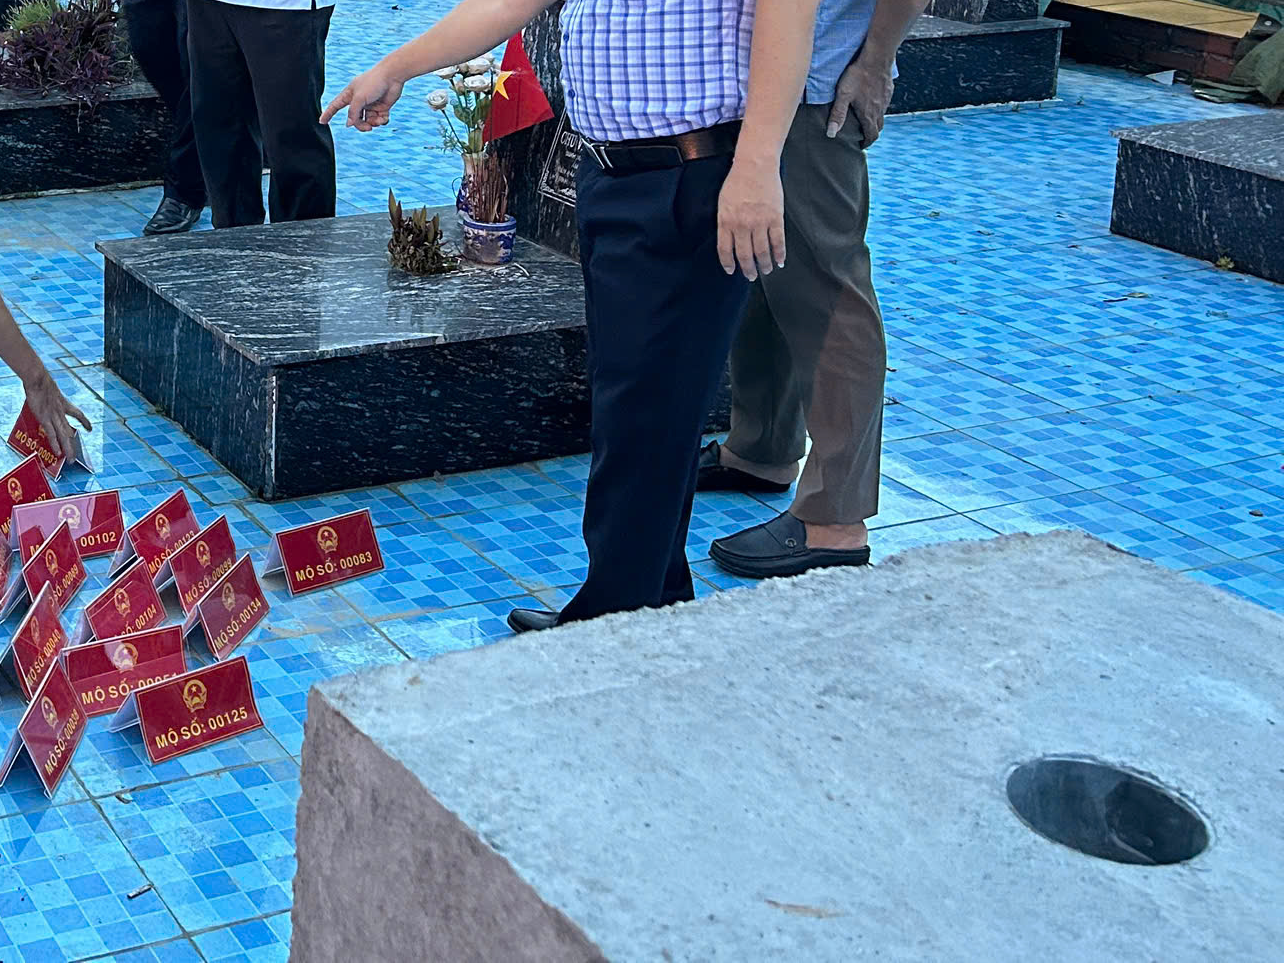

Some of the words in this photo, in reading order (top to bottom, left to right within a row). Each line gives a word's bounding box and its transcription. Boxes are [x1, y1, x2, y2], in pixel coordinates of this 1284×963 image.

[80, 531, 117, 547] 00102
[295, 564, 315, 581] MỘ
[316, 556, 338, 576] SỐ:
[339, 551, 373, 570] 00083
[184, 584, 198, 604] MỘ
[135, 603, 157, 630] 00104
[213, 629, 229, 651] MỘ
[239, 597, 262, 624] 00134
[81, 685, 106, 705] MỘ
[155, 727, 179, 749] MỘ
[180, 716, 207, 740] SỐ:
[208, 706, 248, 730] 00125
